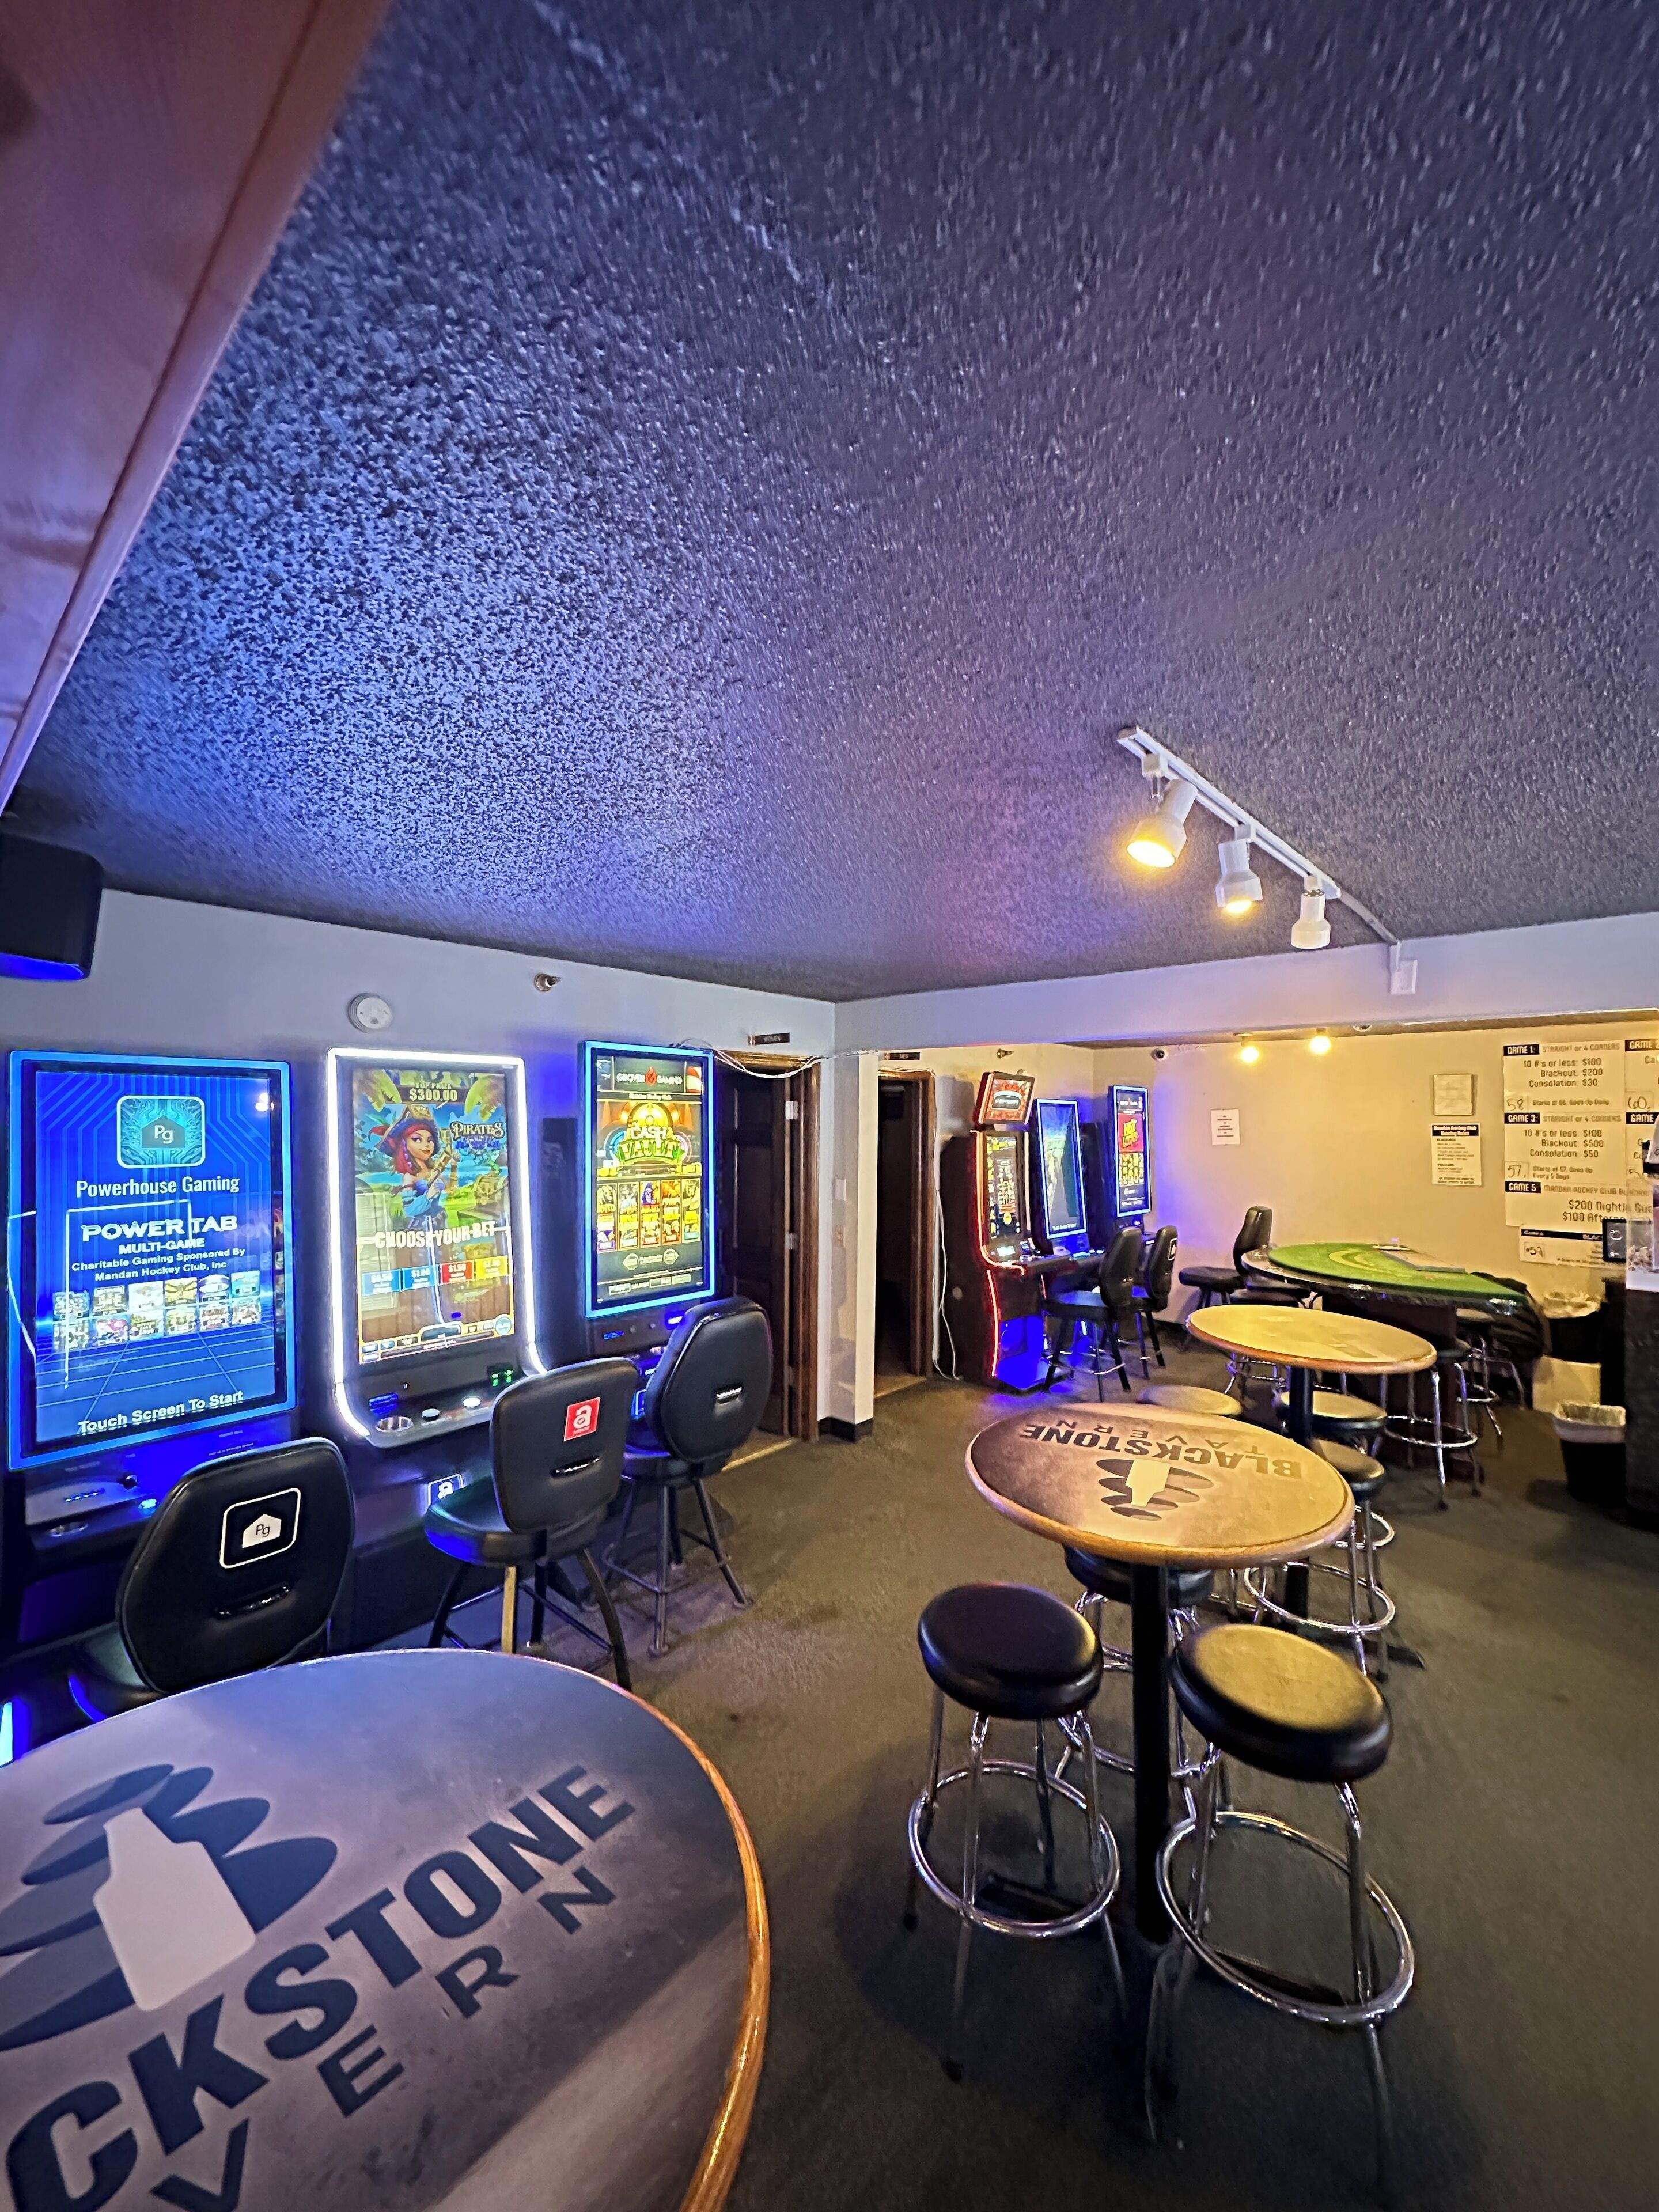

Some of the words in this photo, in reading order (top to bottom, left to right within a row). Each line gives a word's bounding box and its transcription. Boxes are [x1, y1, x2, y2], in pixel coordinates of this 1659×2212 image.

[1507, 1046, 1528, 1054] GAME
[1629, 1040, 1653, 1050] GAME
[1582, 1058, 1601, 1066] $100
[1582, 1067, 1603, 1077] $200
[1582, 1078, 1598, 1087] $30
[409, 1088, 458, 1101] $300.00
[1506, 1099, 1524, 1111] 58
[1508, 1114, 1528, 1123] GAME
[1631, 1113, 1654, 1123] GAME
[153, 1124, 174, 1143] Pg
[450, 1122, 505, 1140] PIRATES
[631, 1124, 667, 1140] CASH
[1524, 1129, 1532, 1137] 10
[1583, 1129, 1603, 1138] $100
[620, 1139, 679, 1160] VAULT
[1583, 1139, 1604, 1148] $500
[1583, 1149, 1599, 1158] $50
[76, 1177, 177, 1198] Powerhouse
[181, 1176, 240, 1194] Gaming
[1509, 1183, 1529, 1192] GAME
[1531, 1183, 1536, 1192] 5
[1569, 1199, 1593, 1210] $200
[1562, 1211, 1585, 1221] $100
[81, 1219, 185, 1242] POWER
[191, 1215, 238, 1234] TAB
[375, 1229, 435, 1248] CHOOSE
[434, 1225, 471, 1247] YOUR
[471, 1221, 497, 1238] BET
[119, 1237, 206, 1255] MULTI-GAME
[71, 1257, 130, 1272] Charitable
[132, 1254, 174, 1268] Gaming
[176, 1248, 227, 1264] Sponsored
[229, 1247, 246, 1257] By
[94, 1270, 139, 1282] Mandan
[141, 1265, 181, 1277] Hockey
[183, 1263, 210, 1272] Club,
[211, 1260, 227, 1270] Inc
[78, 1412, 128, 1433] Touch
[131, 1403, 185, 1423] Screen
[188, 1398, 206, 1411] To
[209, 1390, 244, 1406] Start
[1055, 1419, 1266, 1457] TAVERN
[1019, 1423, 1302, 1479] BLACKSTONE
[255, 1524, 271, 1538] Pg
